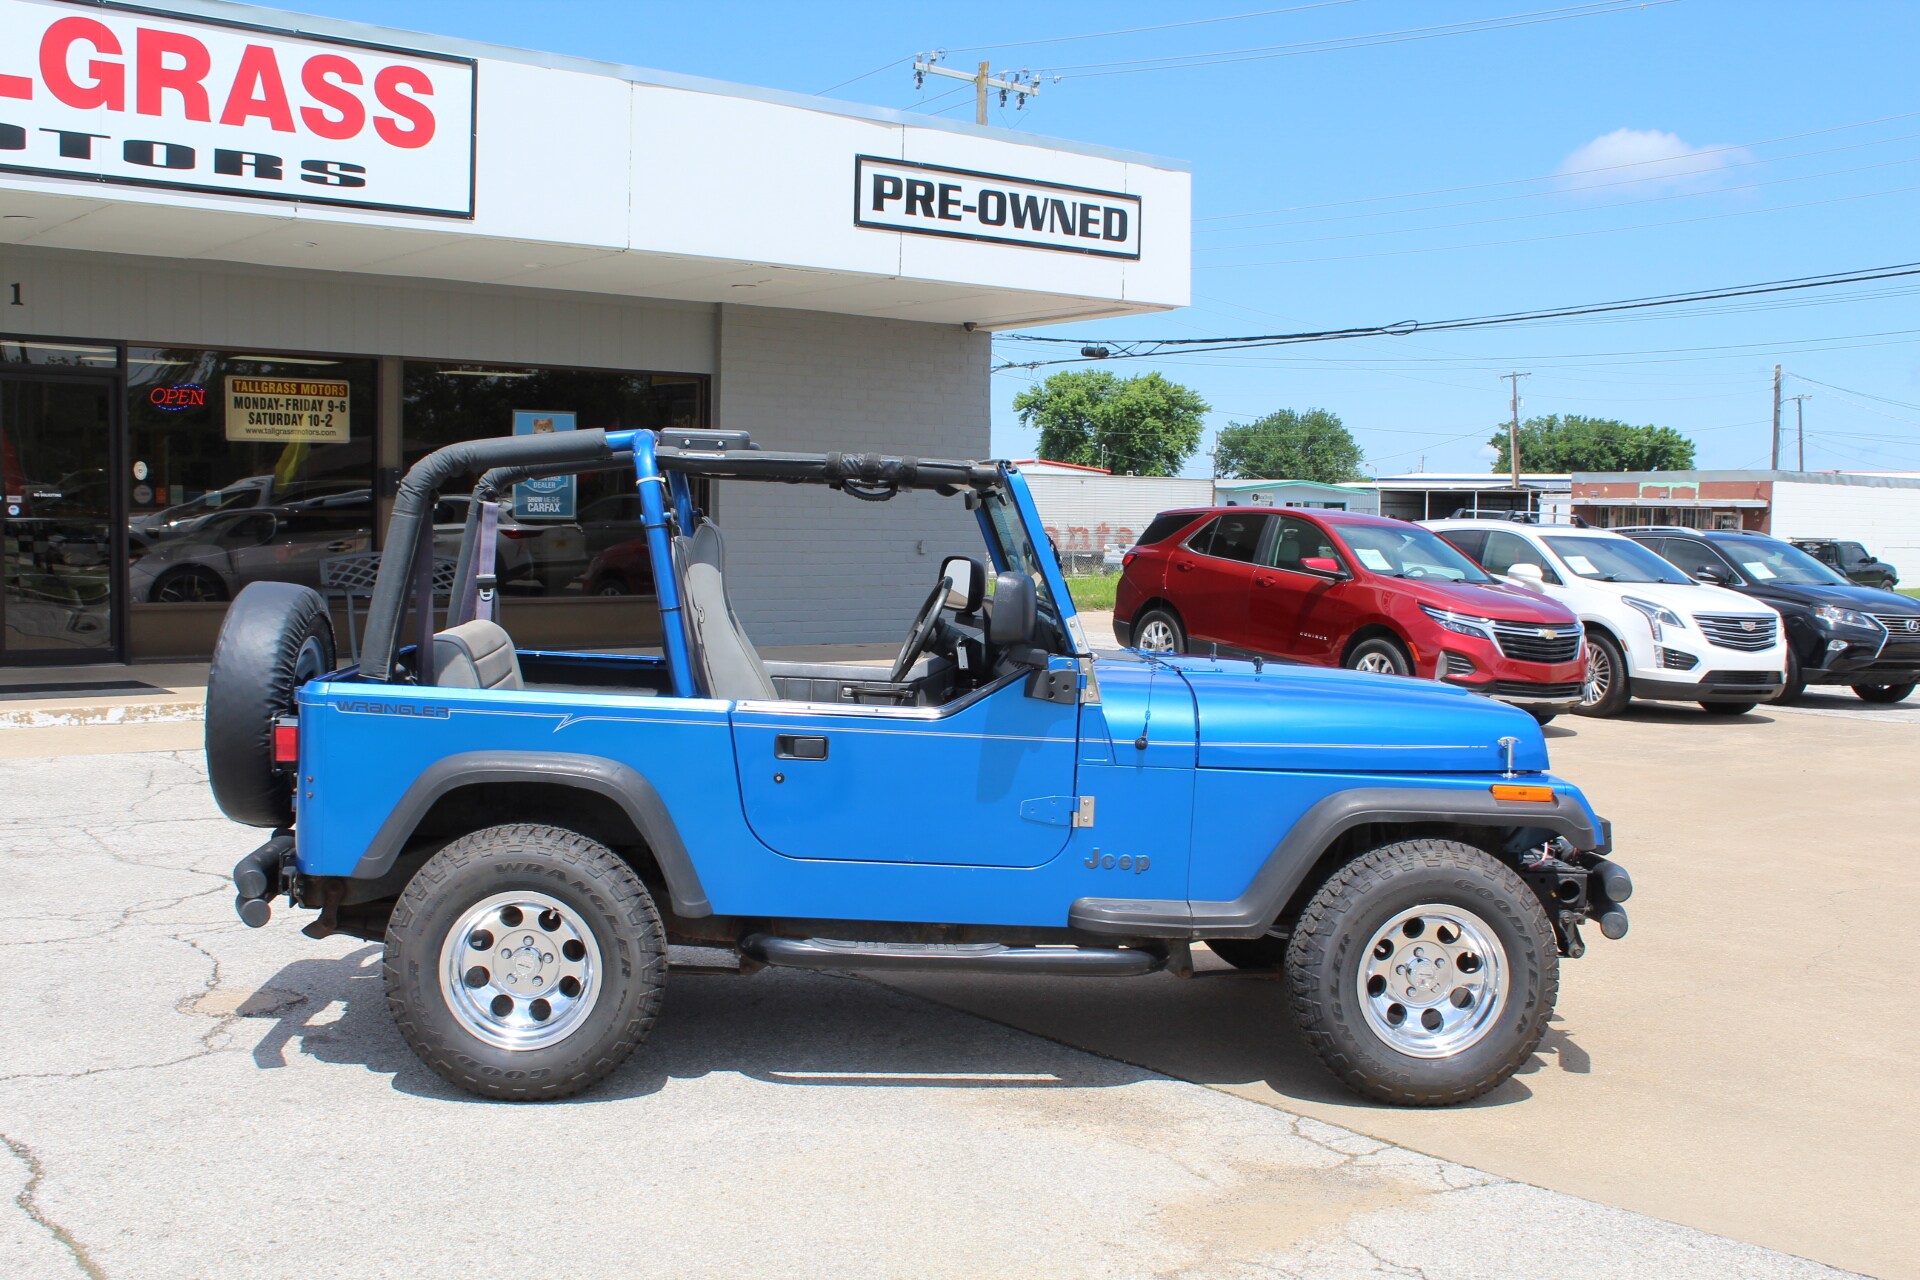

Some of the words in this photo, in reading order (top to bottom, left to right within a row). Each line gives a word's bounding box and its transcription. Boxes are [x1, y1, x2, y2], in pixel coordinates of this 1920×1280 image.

[872, 173, 1128, 243] PRE-OWNED
[11, 282, 25, 306] 1
[150, 387, 206, 405] OPEN
[235, 380, 297, 394] TALLGRASS
[300, 384, 346, 396] MOTORS
[234, 396, 324, 412] MONDAY-FRIDAY
[327, 400, 347, 413] 9-6
[248, 412, 303, 426] SATURDAY
[308, 414, 333, 427] 10-2
[527, 502, 561, 513] CARFAX
[336, 700, 450, 717] WRANGLER
[1083, 847, 1151, 874] Jeep
[1453, 878, 1540, 1036] GOODYEAR
